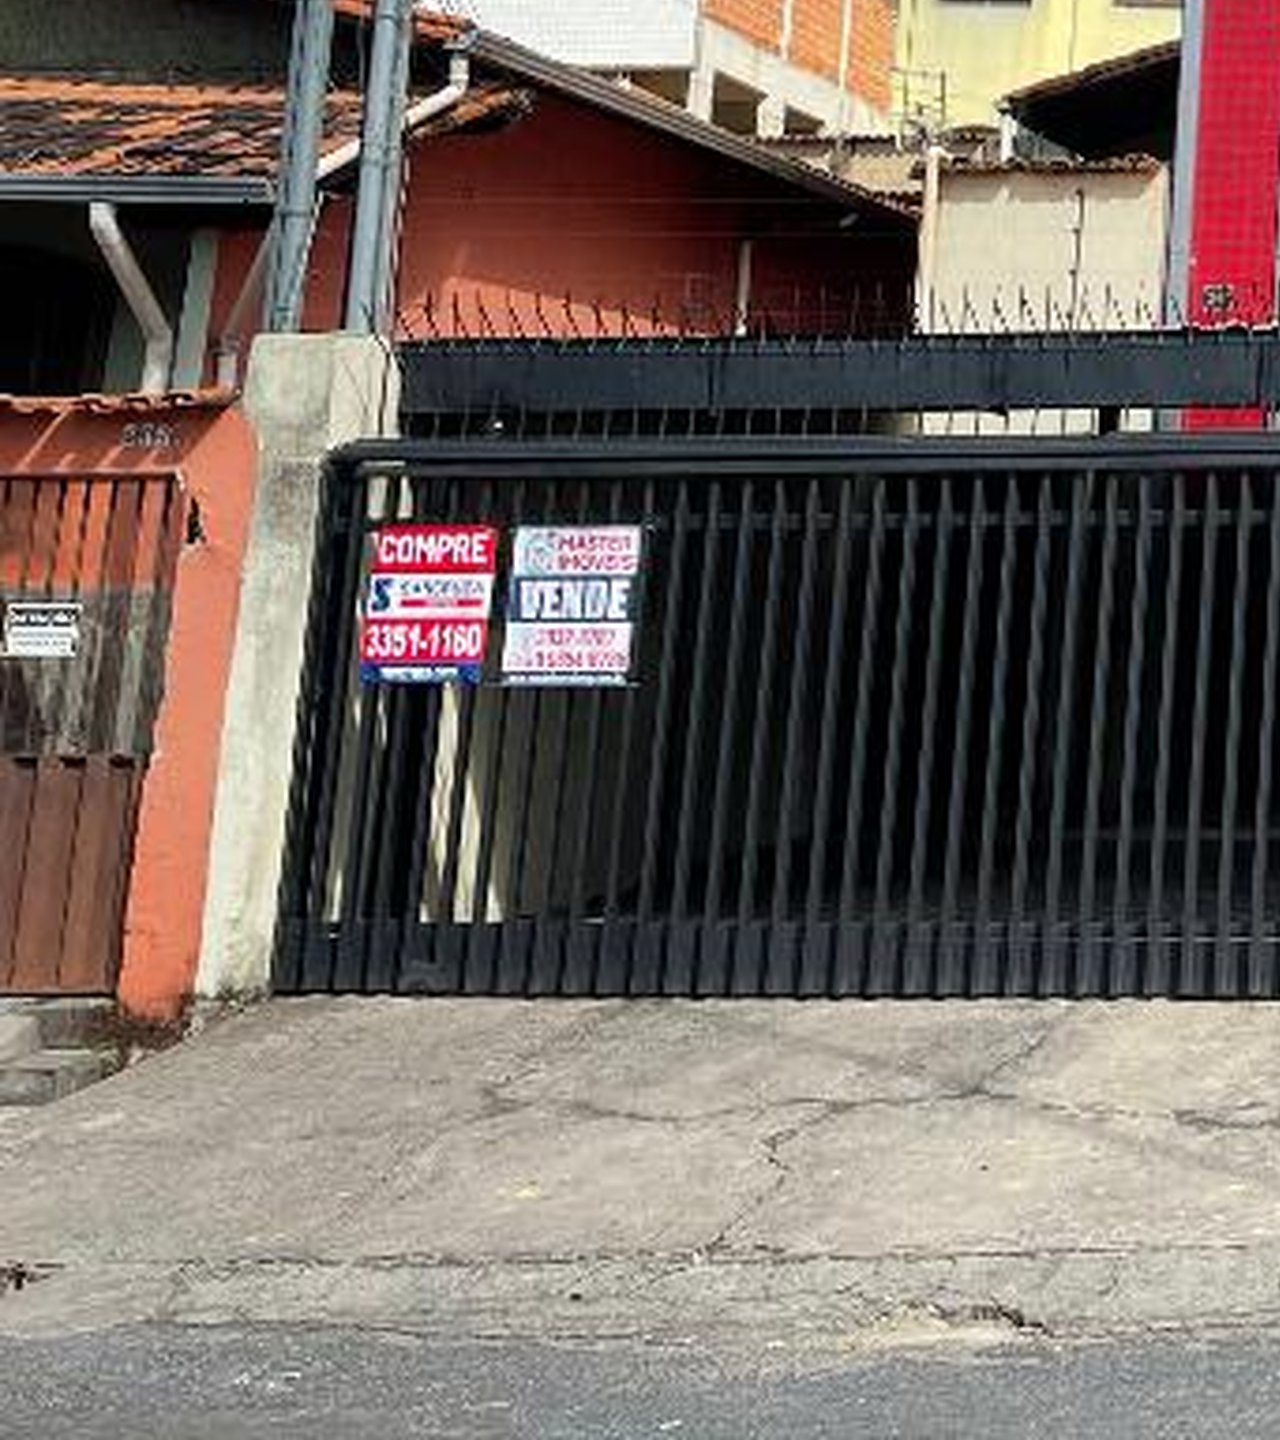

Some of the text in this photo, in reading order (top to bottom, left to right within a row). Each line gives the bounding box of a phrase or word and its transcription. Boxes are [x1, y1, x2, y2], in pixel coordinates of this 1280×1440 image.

[379, 533, 489, 563] COMPRE
[519, 579, 631, 619] VENDE
[366, 624, 482, 658] 3351-1160
